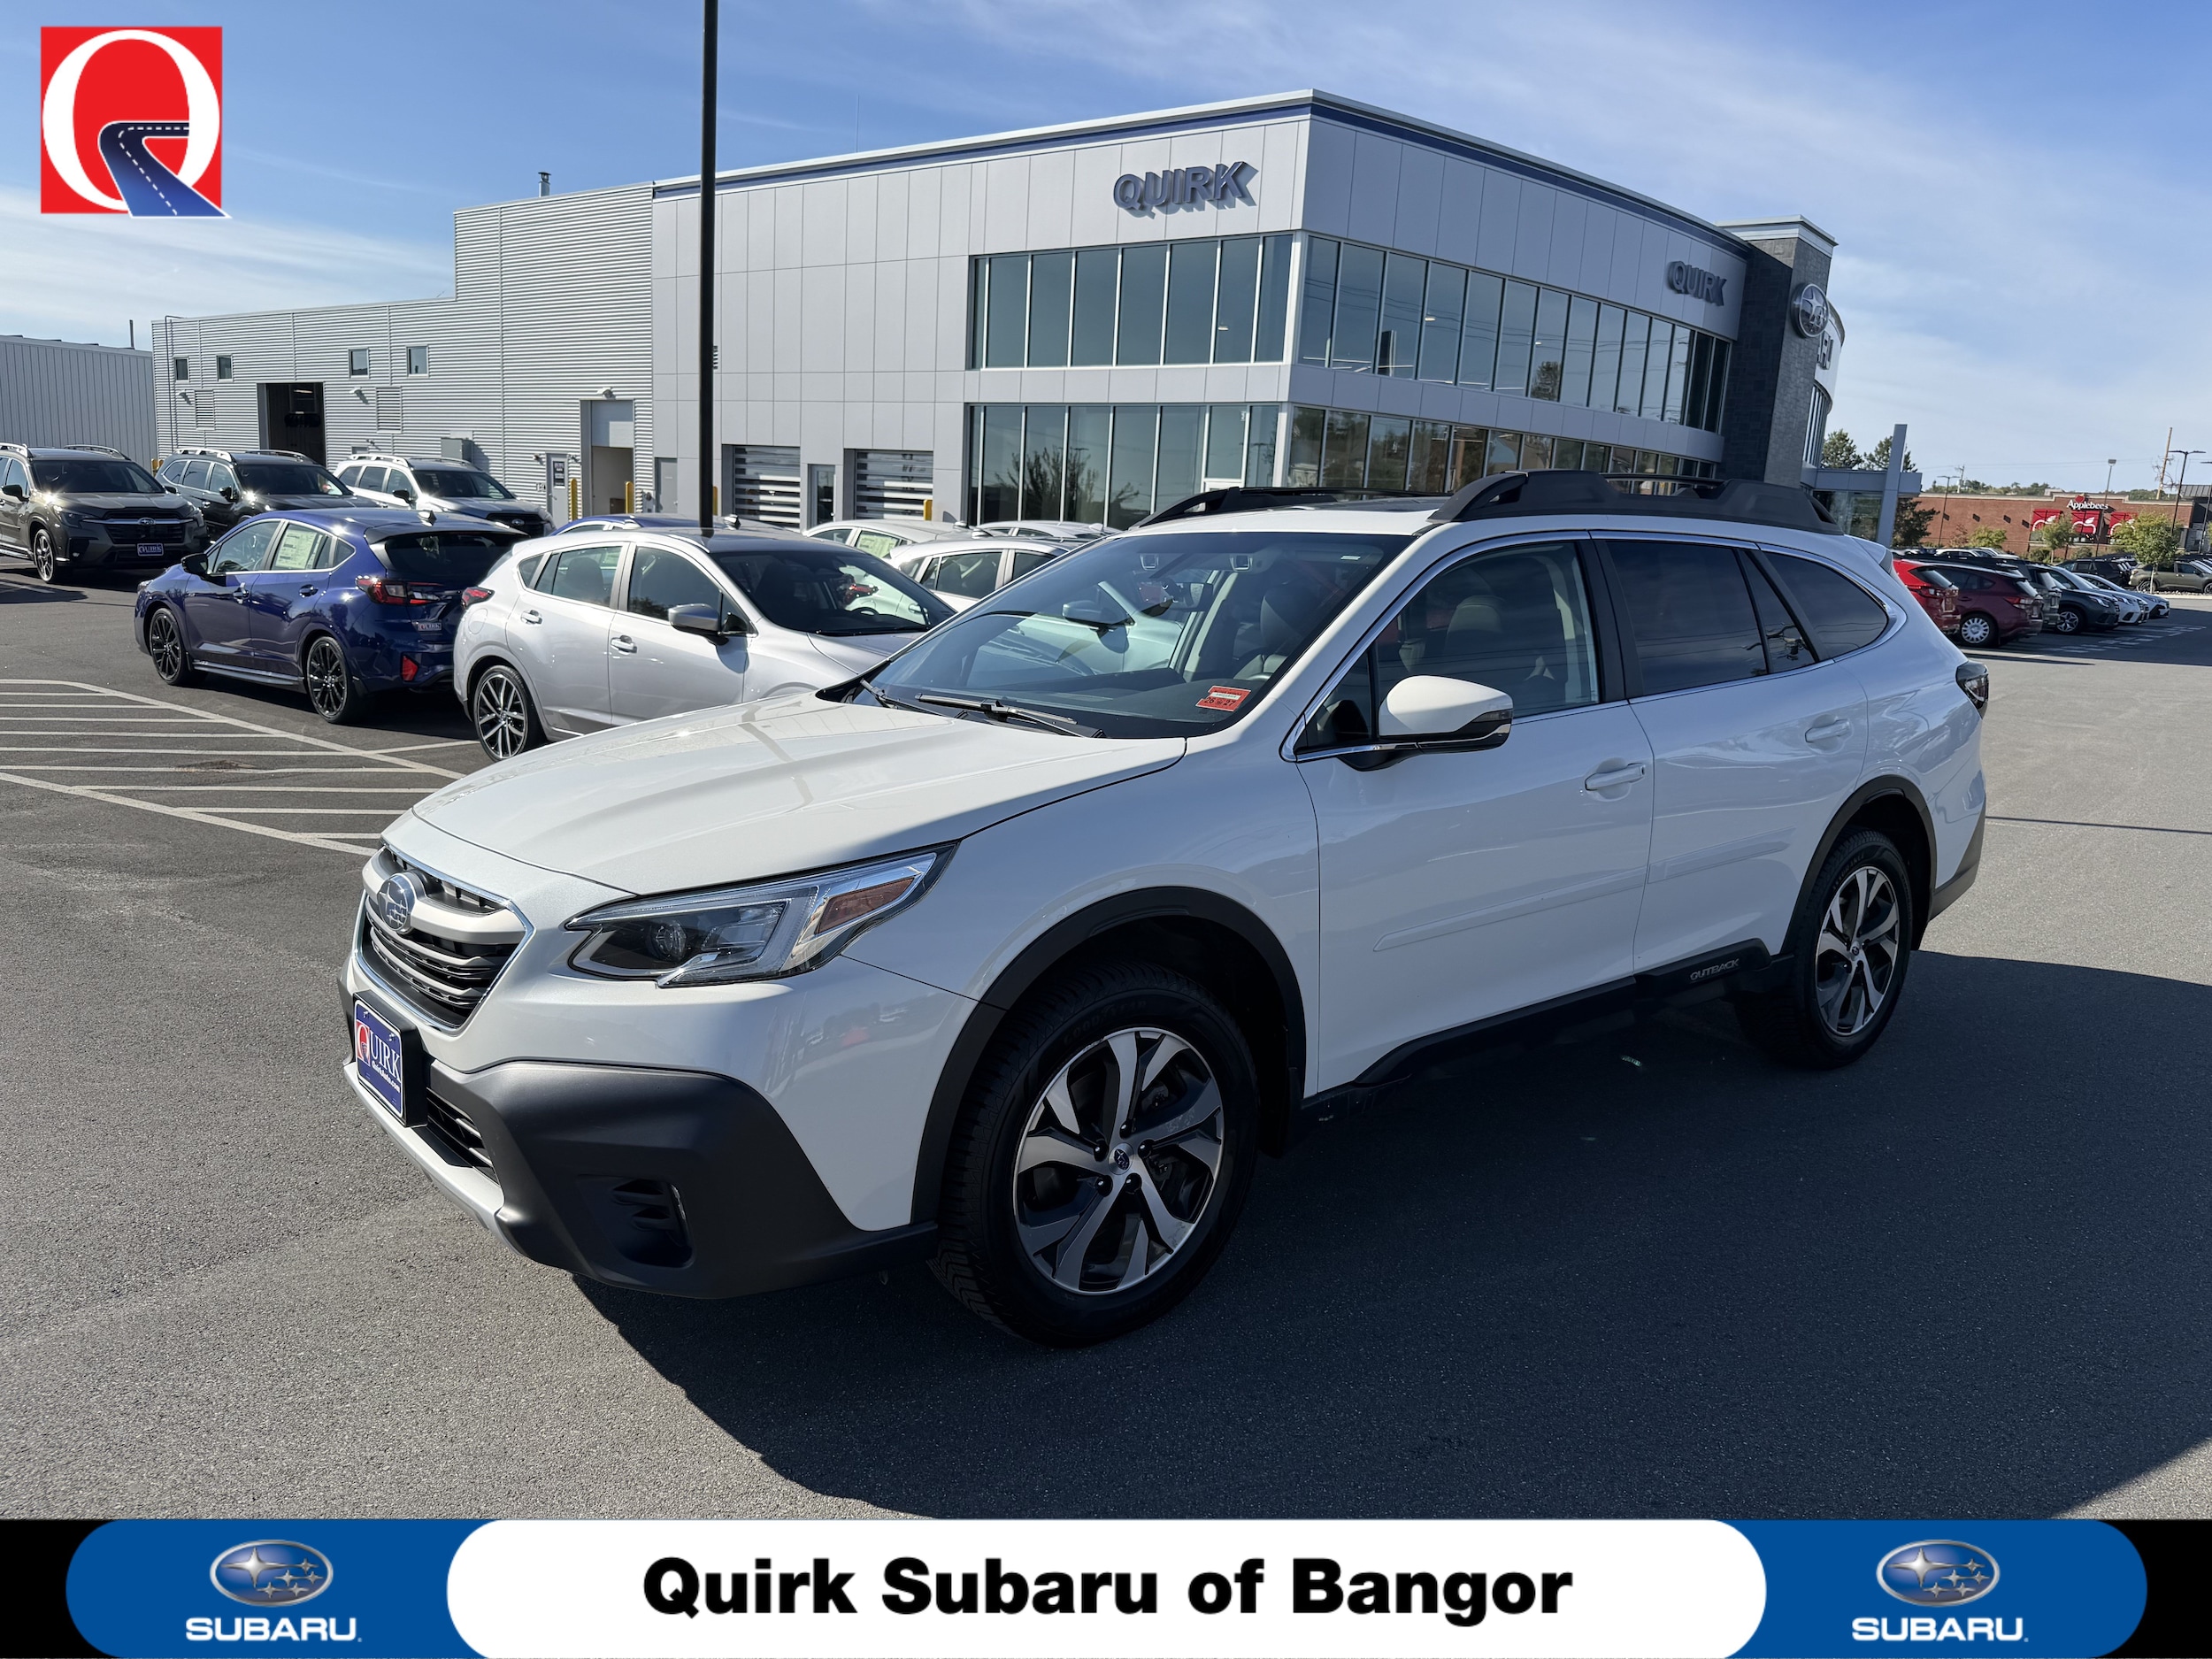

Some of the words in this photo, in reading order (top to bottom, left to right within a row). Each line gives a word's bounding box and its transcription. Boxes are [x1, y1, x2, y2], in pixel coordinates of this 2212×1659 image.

[1113, 161, 1244, 211] QUIRK
[1668, 260, 1727, 307] QUIRK
[1690, 958, 1740, 980] OUTBACK
[357, 1024, 402, 1083] QUIRK
